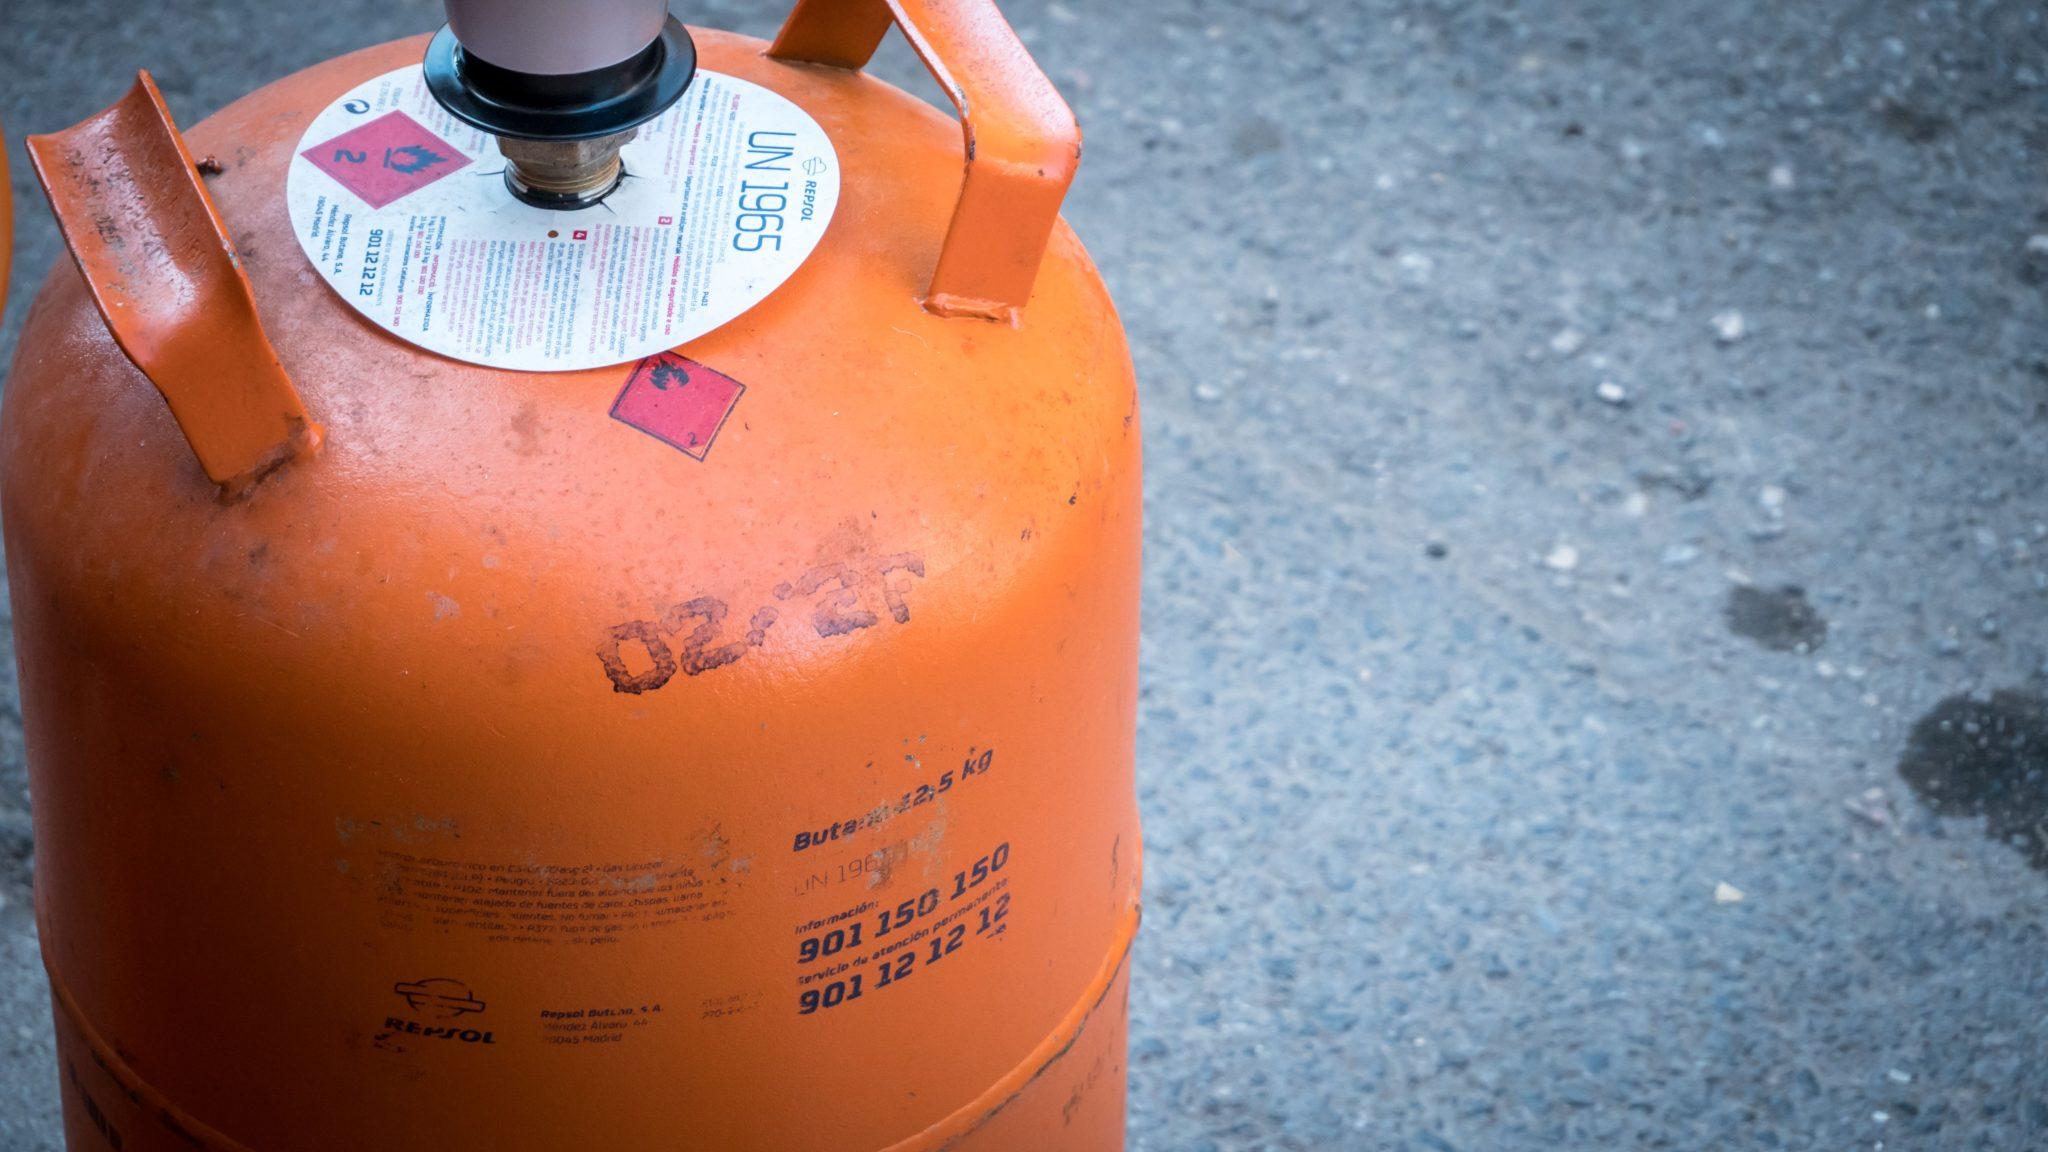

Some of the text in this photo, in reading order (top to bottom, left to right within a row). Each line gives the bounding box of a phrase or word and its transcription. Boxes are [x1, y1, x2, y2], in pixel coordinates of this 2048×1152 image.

[334, 149, 367, 163] 2
[315, 195, 327, 215] 28045
[734, 131, 796, 252] UN 1965
[801, 180, 818, 222] REPSOL
[341, 214, 352, 234] Repsol
[359, 229, 384, 296] 901 12 12 12
[962, 749, 993, 780] kg
[797, 842, 1010, 965] 901 150 150
[797, 974, 864, 1015] 901
[873, 951, 917, 990] 12
[925, 923, 967, 966] 12
[975, 892, 1012, 936] 12
[872, 925, 930, 961] atención
[540, 1007, 586, 1019] Repsol
